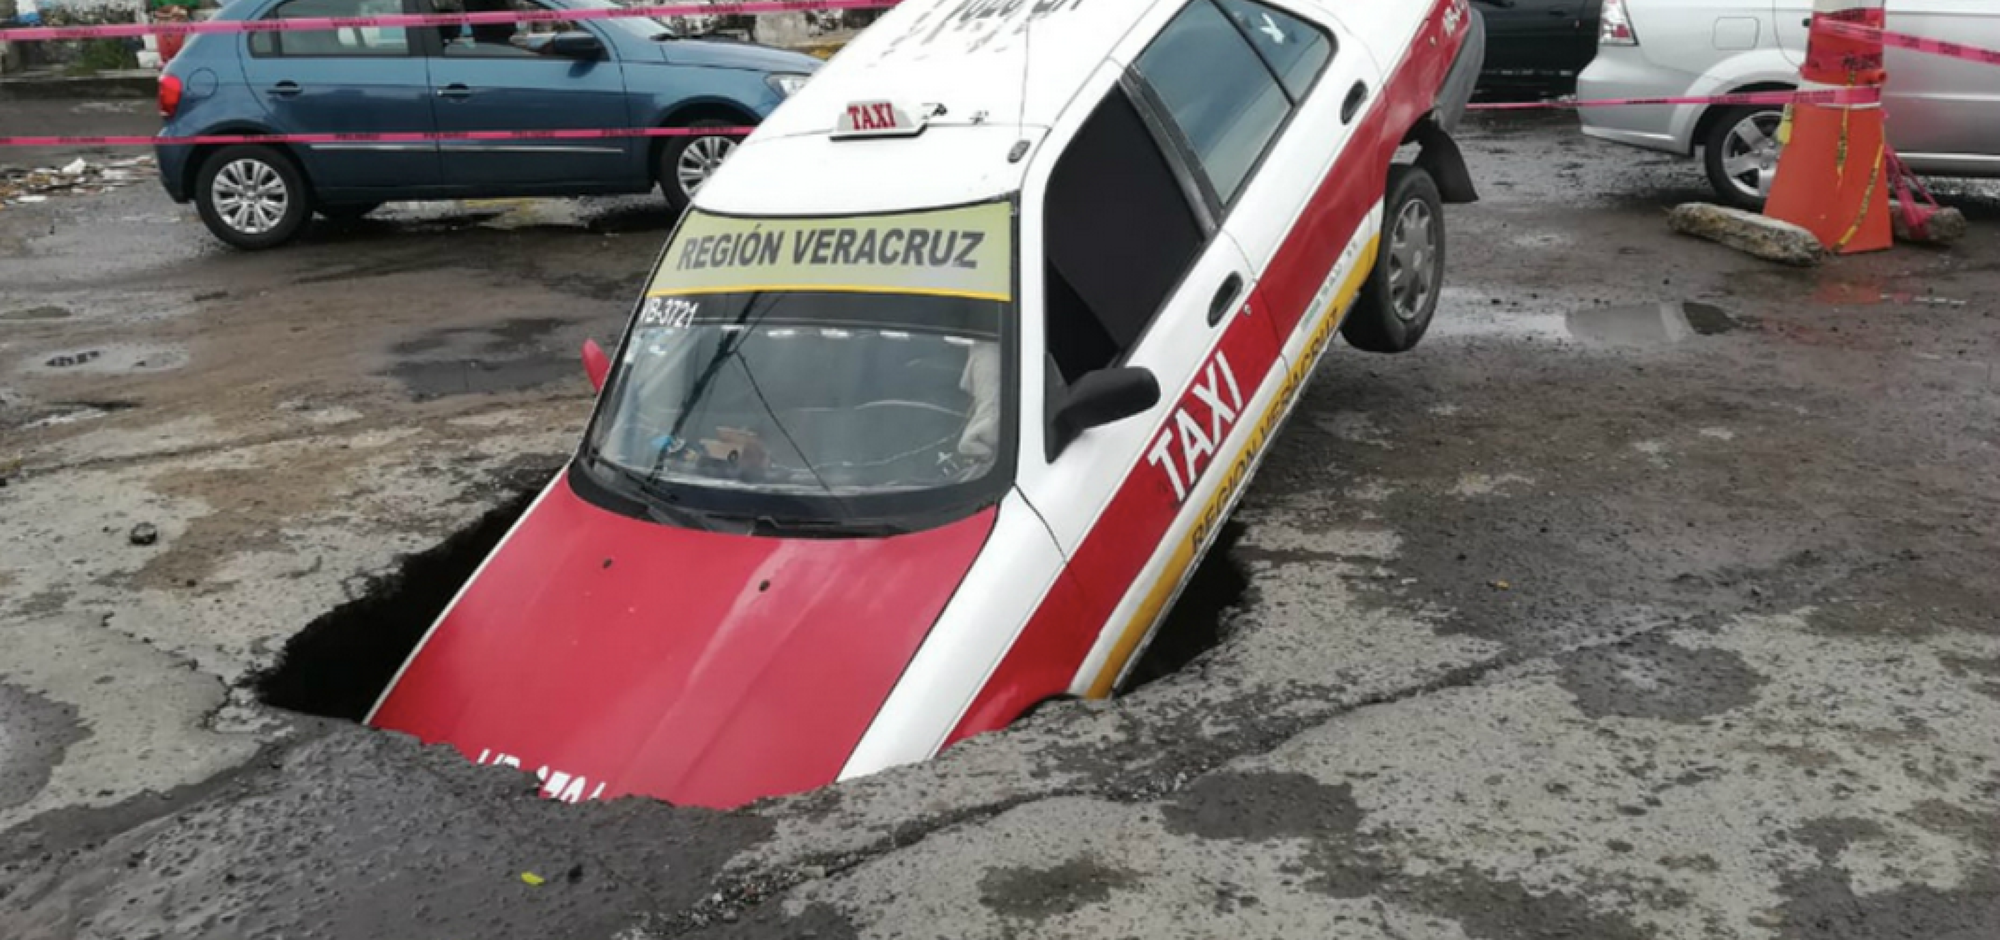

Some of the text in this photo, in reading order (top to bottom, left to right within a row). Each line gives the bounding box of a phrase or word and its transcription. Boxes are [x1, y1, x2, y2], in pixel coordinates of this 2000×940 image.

[847, 103, 897, 130] TAXI
[677, 223, 985, 270] REGIÓN VERACRUZ
[1148, 351, 1243, 501] TAXI
